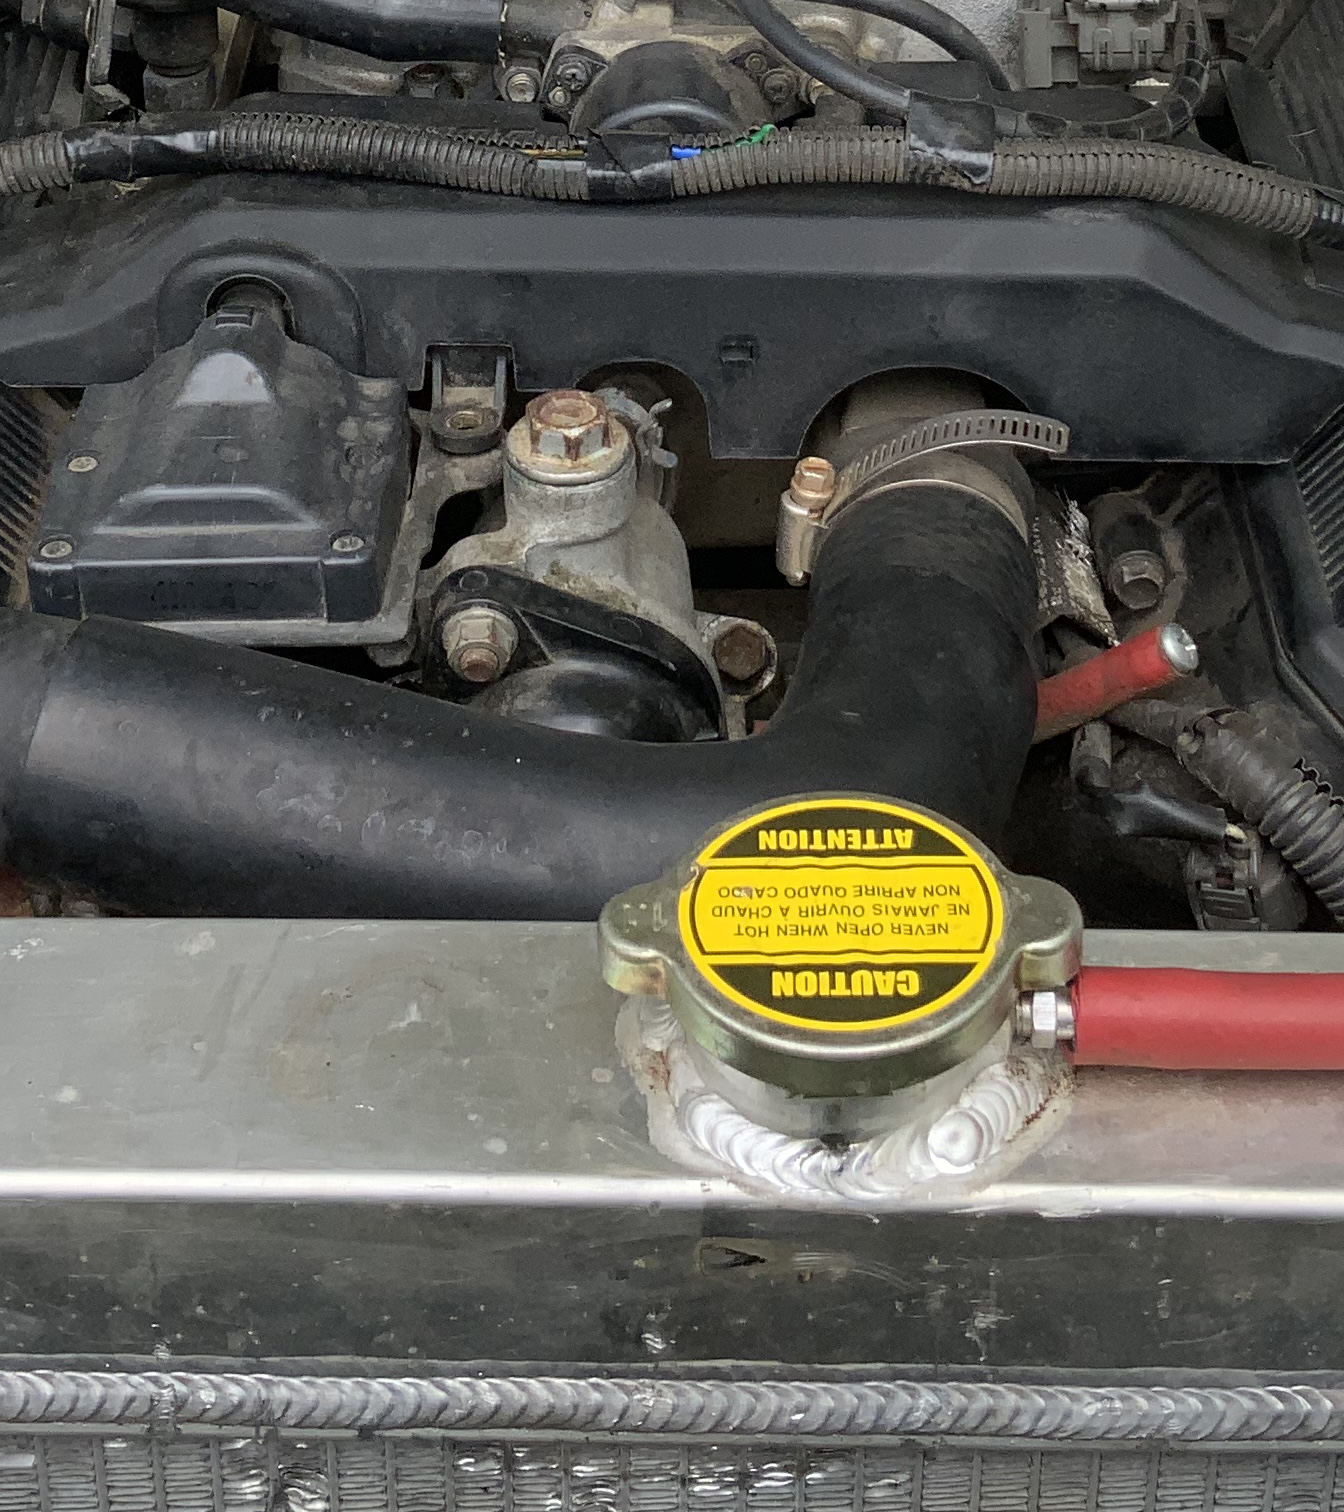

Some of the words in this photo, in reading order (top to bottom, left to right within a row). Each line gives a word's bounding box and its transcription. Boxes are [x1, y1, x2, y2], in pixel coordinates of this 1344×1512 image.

[758, 828, 914, 851] ATTENTION
[783, 884, 847, 898] QUADO
[852, 884, 917, 898] APRIRE
[922, 884, 960, 898] NON
[711, 905, 772, 919] CHAUD
[797, 903, 865, 918] OUVRIR
[872, 903, 939, 917] JAMAIS
[947, 903, 970, 916] NE
[733, 922, 770, 938] HOT
[776, 922, 829, 937] WHEN
[835, 921, 884, 936] OPEN
[890, 921, 949, 936] NEVER
[771, 969, 920, 997] CAUTION
